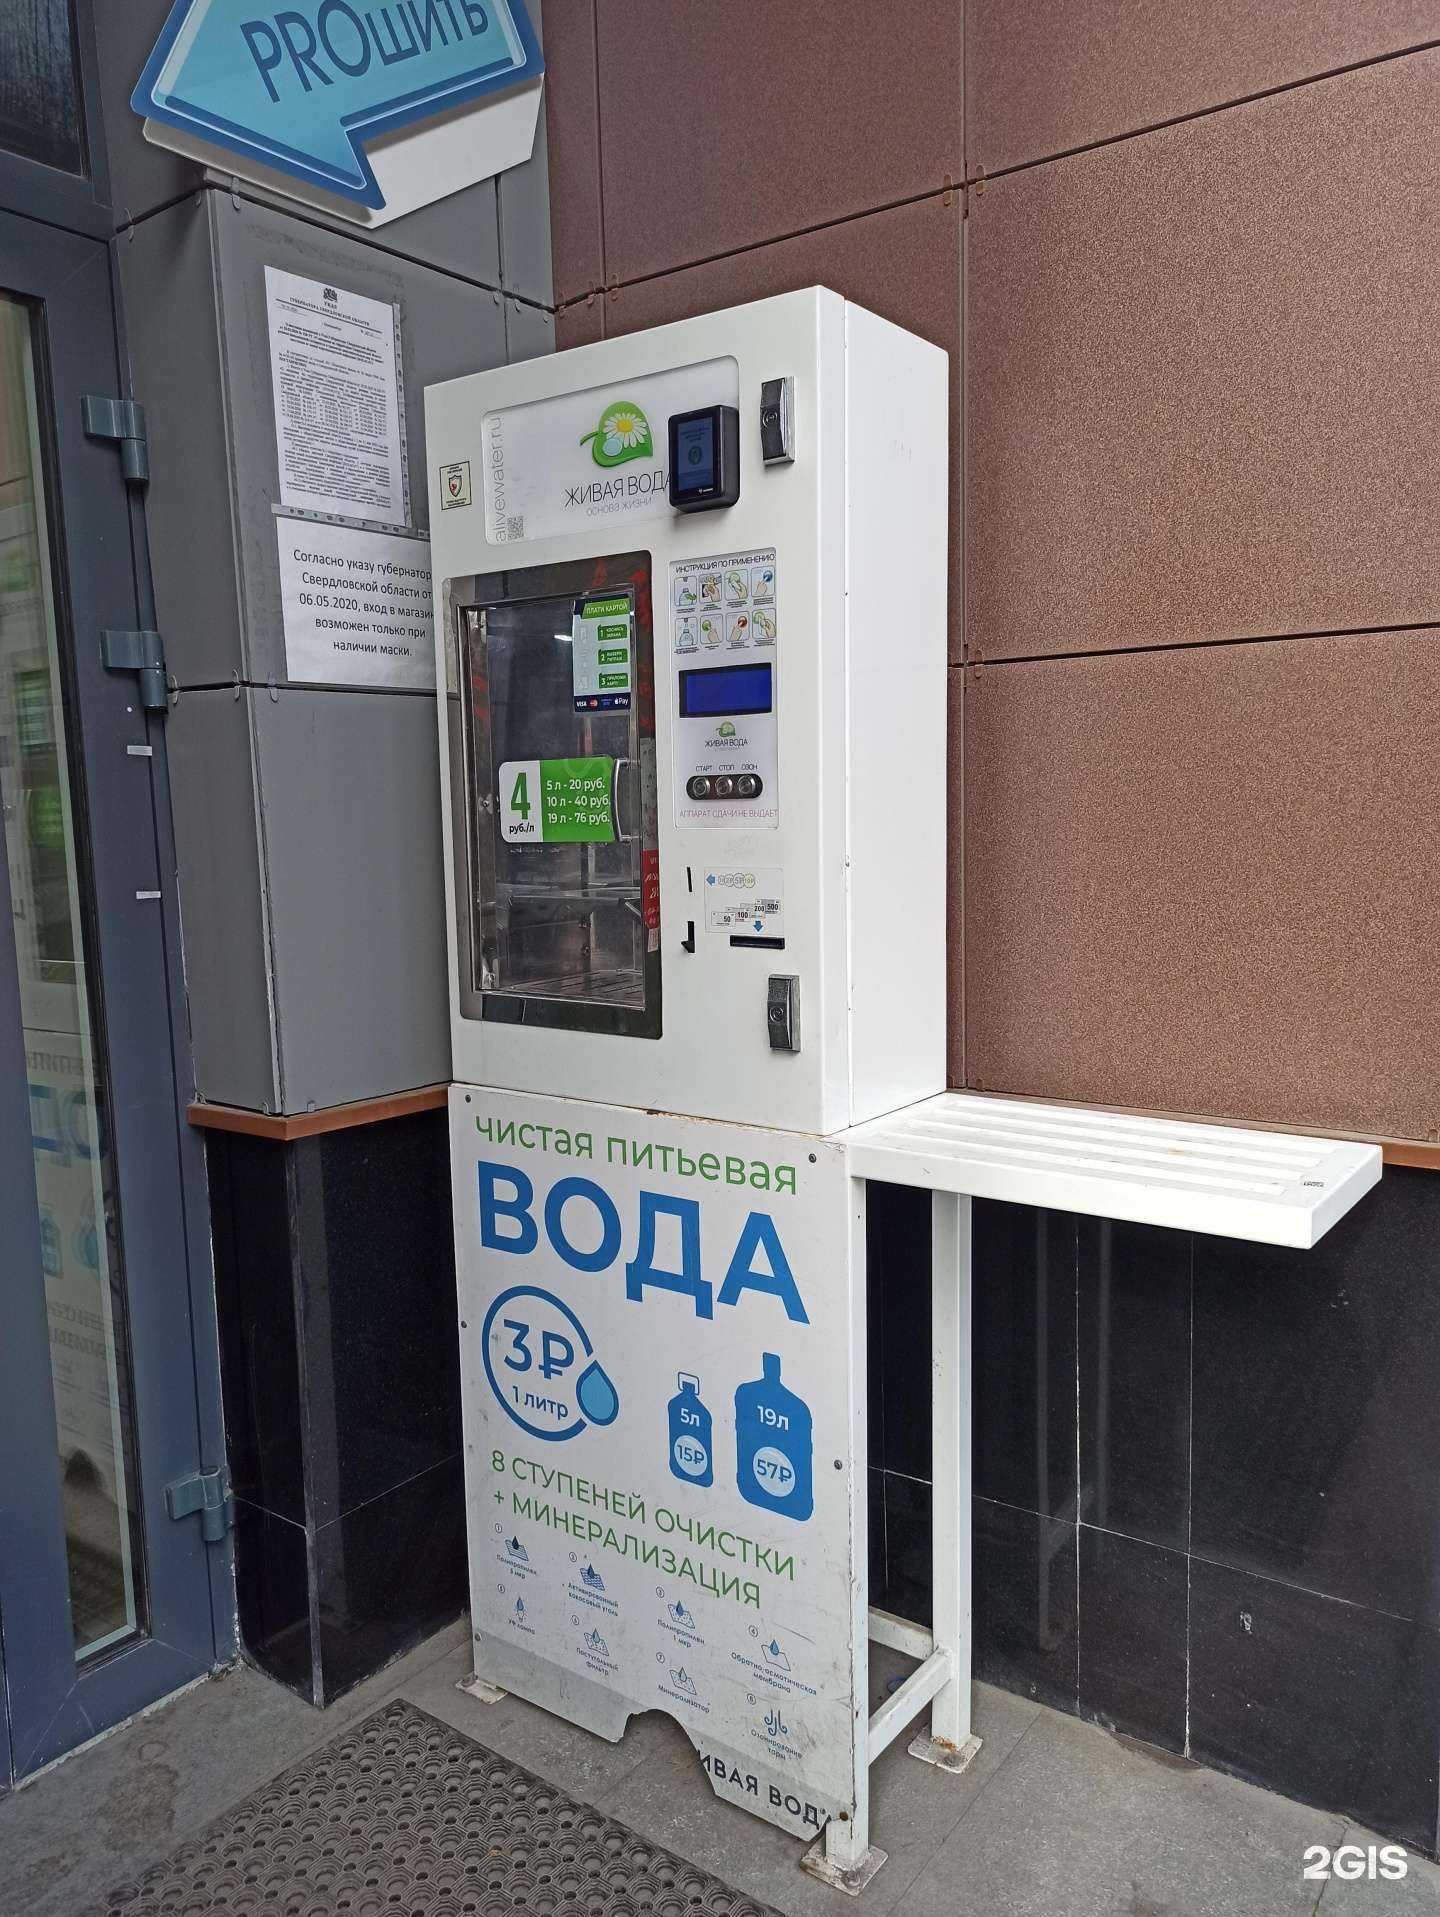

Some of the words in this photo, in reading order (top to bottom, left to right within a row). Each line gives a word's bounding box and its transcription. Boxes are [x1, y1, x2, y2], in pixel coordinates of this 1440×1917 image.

[565, 478, 623, 507] ЖИВАЯ
[587, 503, 619, 516] основа
[622, 497, 652, 512] жизни
[294, 550, 344, 567] Согласно
[347, 560, 375, 574] указу
[675, 561, 718, 573] ИНСТРУКЦИЯ
[719, 560, 728, 568] ПО
[302, 572, 378, 593] Свердловской
[381, 583, 420, 598] области
[422, 589, 432, 600] от
[299, 593, 361, 612] 06.05.2020,
[363, 603, 388, 615] вход
[390, 606, 396, 615] в
[586, 606, 605, 614] ПЛАТИ
[605, 603, 628, 612] КАРТОЙ
[315, 618, 369, 632] возможен
[372, 624, 406, 636] только
[408, 628, 426, 640] при
[333, 641, 377, 653] наличии
[380, 646, 412, 656] маски.
[705, 739, 728, 748] ЖИВАЯ
[729, 738, 748, 747] ВОДА
[741, 763, 758, 771] ОЗОН
[546, 780, 553, 790] 5
[569, 779, 581, 790] 20
[584, 778, 605, 791] руб.
[510, 772, 531, 820] 4
[547, 797, 557, 807] 10
[559, 798, 566, 806] л
[574, 796, 587, 806] 40
[590, 794, 611, 808] руб.
[548, 813, 557, 824] 19
[559, 815, 566, 823] л
[574, 813, 587, 823] 76
[589, 812, 610, 825] руб.
[680, 809, 711, 818] АППАРАТ
[712, 809, 737, 818] СДАЧИ
[509, 823, 535, 834] руб./л
[475, 1116, 593, 1159] чистая
[607, 1137, 797, 1195] питьевая
[477, 1160, 810, 1325] ВОДА
[512, 1385, 519, 1403] 1
[524, 1392, 568, 1420] литр
[680, 1407, 700, 1427] 5л
[757, 1405, 789, 1431] 19л
[492, 1450, 505, 1473] 8
[512, 1456, 646, 1525] СТУПЕНЕЙ
[655, 1508, 796, 1582] ОЧИСТКИ
[512, 1491, 761, 1610] МИНЕРАЛИЗАЦИЯ
[753, 1672, 791, 1693] мембрана
[769, 1784, 832, 1831] ВОД
